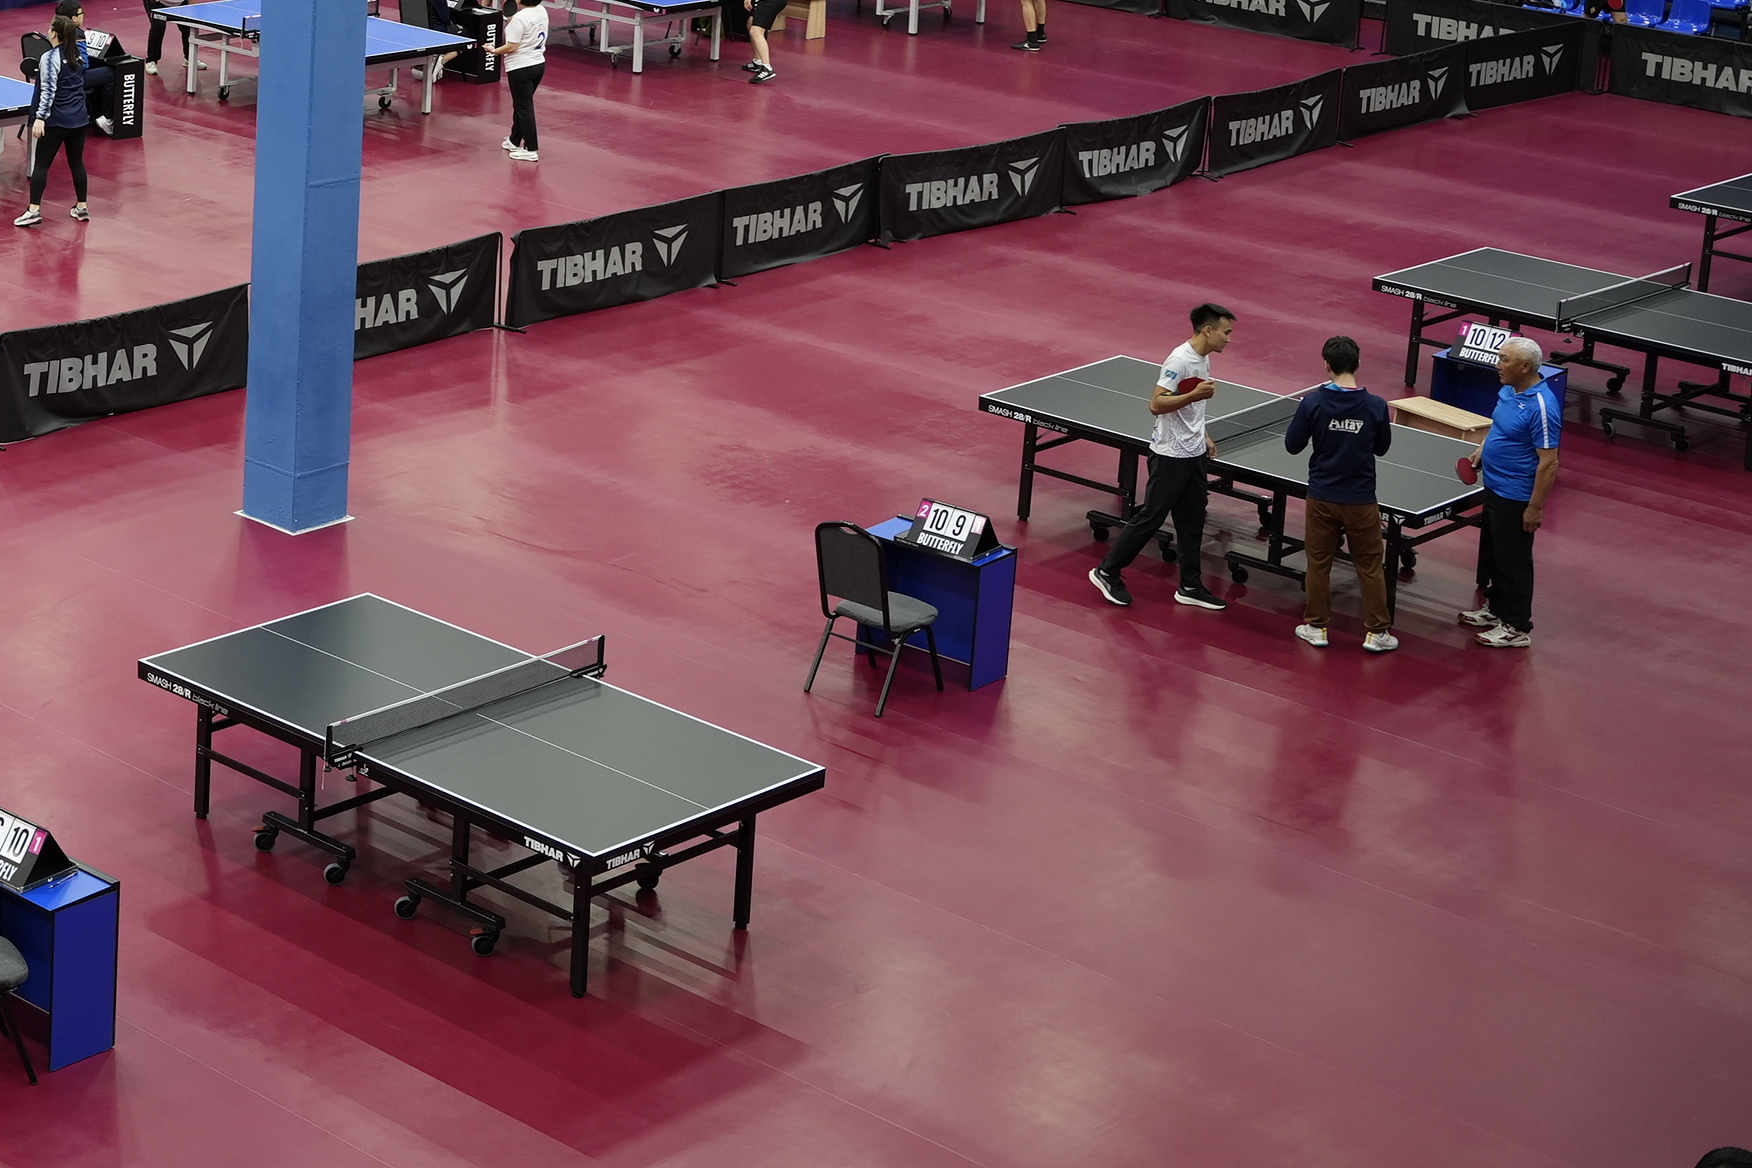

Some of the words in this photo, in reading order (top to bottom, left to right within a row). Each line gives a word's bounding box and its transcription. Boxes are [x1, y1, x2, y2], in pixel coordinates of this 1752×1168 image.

[88, 32, 95, 45] 9
[96, 34, 107, 48] 10
[534, 32, 545, 50] 2
[1468, 54, 1534, 88] TIBHAR
[122, 74, 136, 126] BUTTERFLY
[1360, 79, 1420, 114] TIBHAR
[1229, 109, 1293, 147] TIBHAR
[1078, 140, 1155, 179] TIBHAR
[905, 173, 998, 211] TIBHAR
[1678, 202, 1700, 213] SMASH
[733, 200, 823, 246] TIBHAR
[537, 241, 643, 291] TIBHAR
[355, 288, 418, 330] HAR
[1381, 285, 1404, 296] SMASH
[1405, 290, 1423, 301] 28/R
[1462, 325, 1467, 335] 1
[1470, 328, 1486, 350] 10
[1489, 331, 1506, 350] 12
[23, 343, 158, 398] TIBHAR
[1459, 347, 1500, 365] BUTTERFLY
[988, 404, 1012, 419] SMASH
[1013, 411, 1032, 424] 28/R
[1032, 417, 1055, 431] black
[1055, 423, 1069, 433] line
[918, 504, 930, 518] 2
[929, 508, 949, 531] 10
[952, 514, 967, 536] 9
[917, 532, 964, 555] BUTTERFLY
[147, 672, 172, 691] SMASH
[172, 684, 191, 699] 28/R
[192, 693, 214, 709] black
[215, 703, 229, 715] line
[6, 826, 30, 858] 10
[33, 836, 42, 852] 1
[524, 835, 564, 862] TIBHAR
[606, 848, 640, 870] TIBHAR
